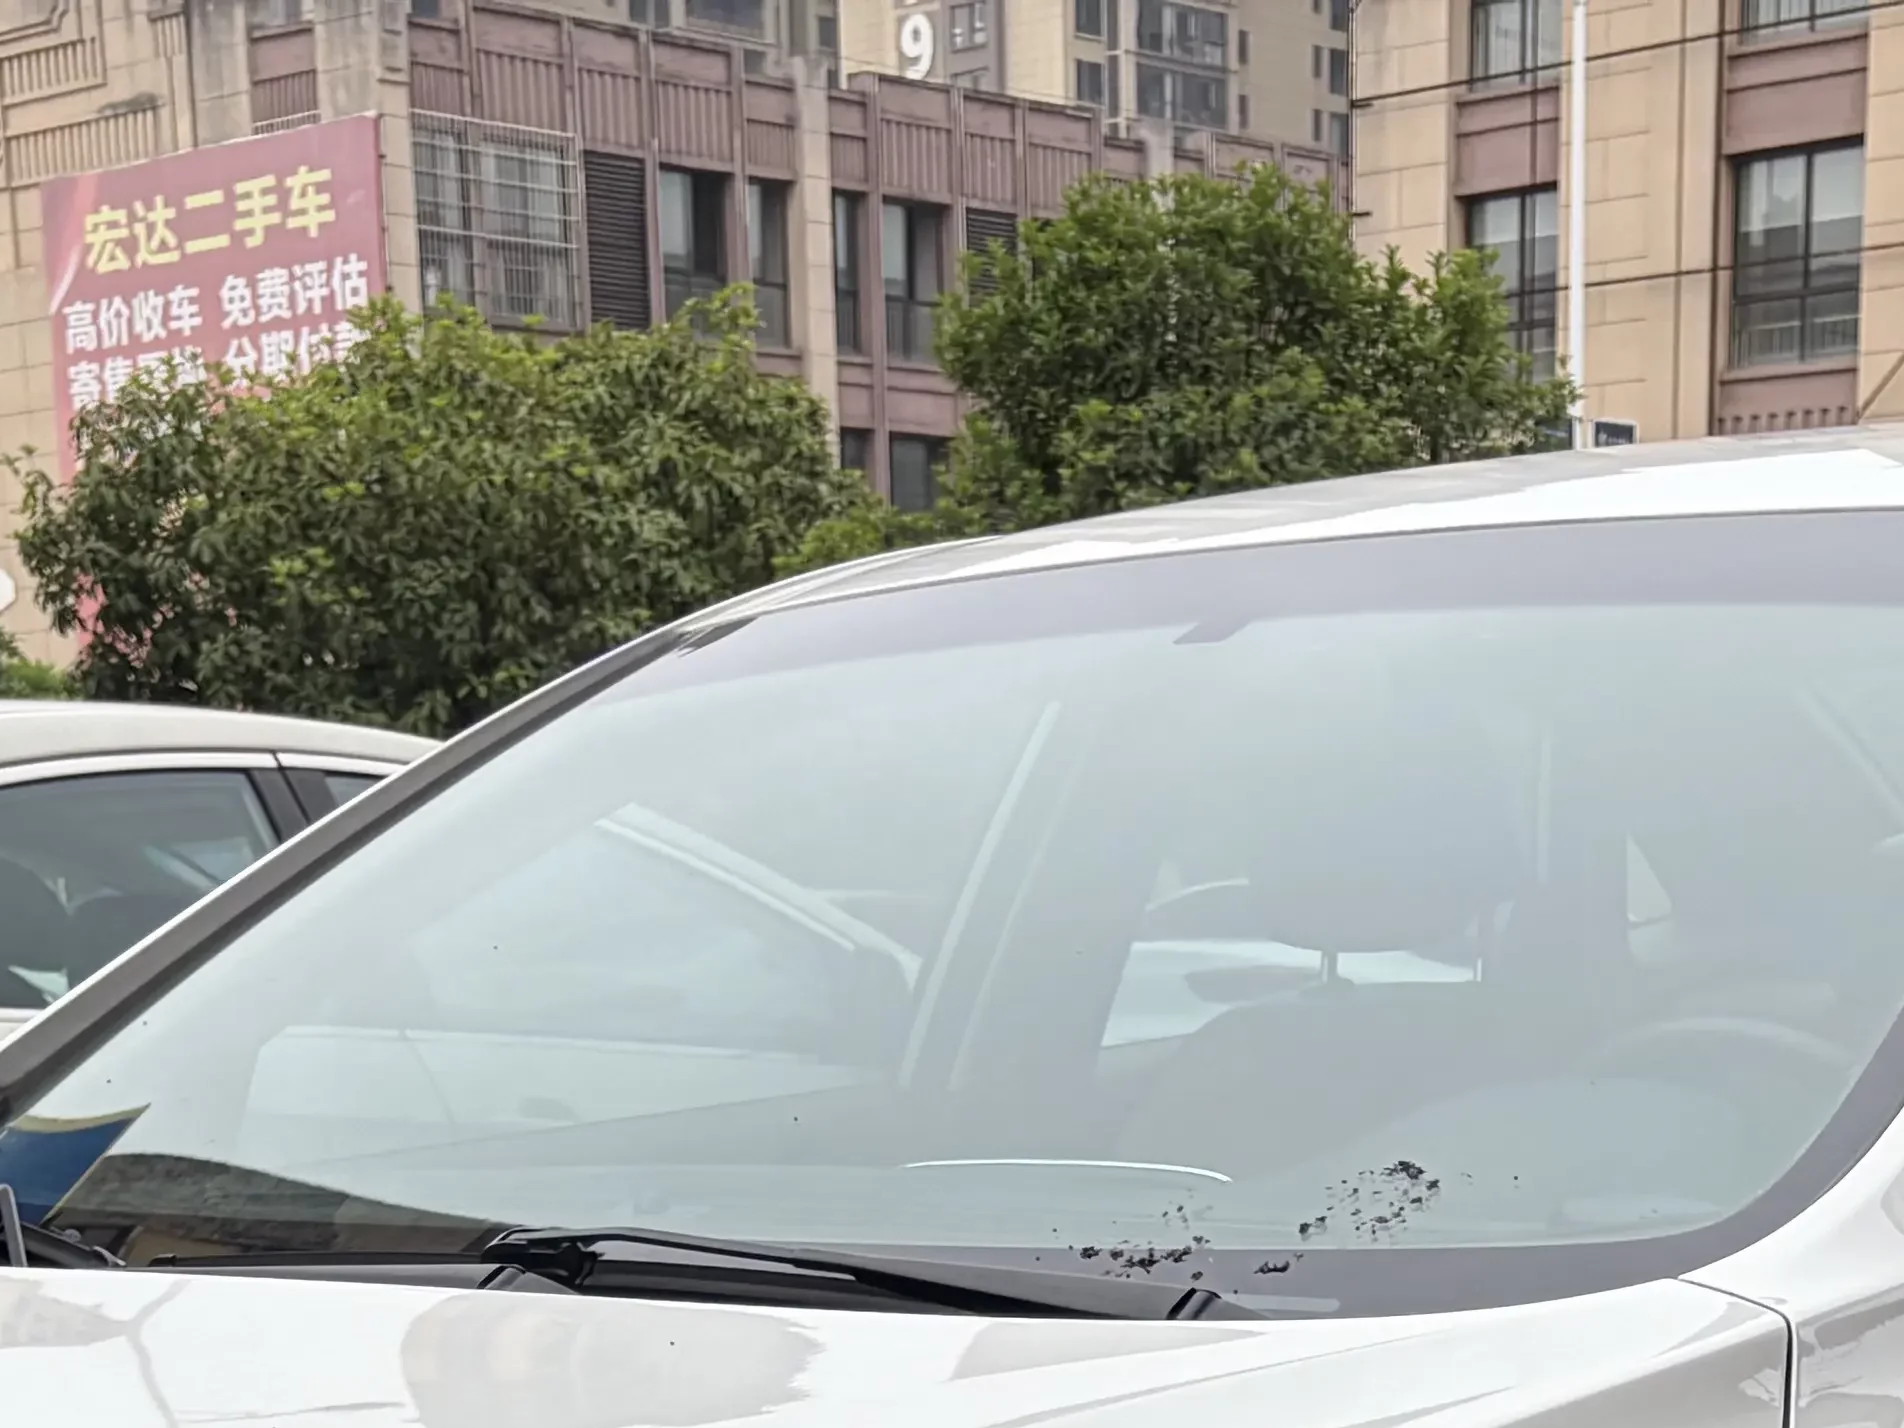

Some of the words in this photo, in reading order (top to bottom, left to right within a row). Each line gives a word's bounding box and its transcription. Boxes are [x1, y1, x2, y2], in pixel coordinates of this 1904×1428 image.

[900, 14, 935, 81] 9
[85, 165, 336, 274] 宏达二手车
[62, 285, 204, 354] 高价收车
[219, 252, 368, 330] 免费评估
